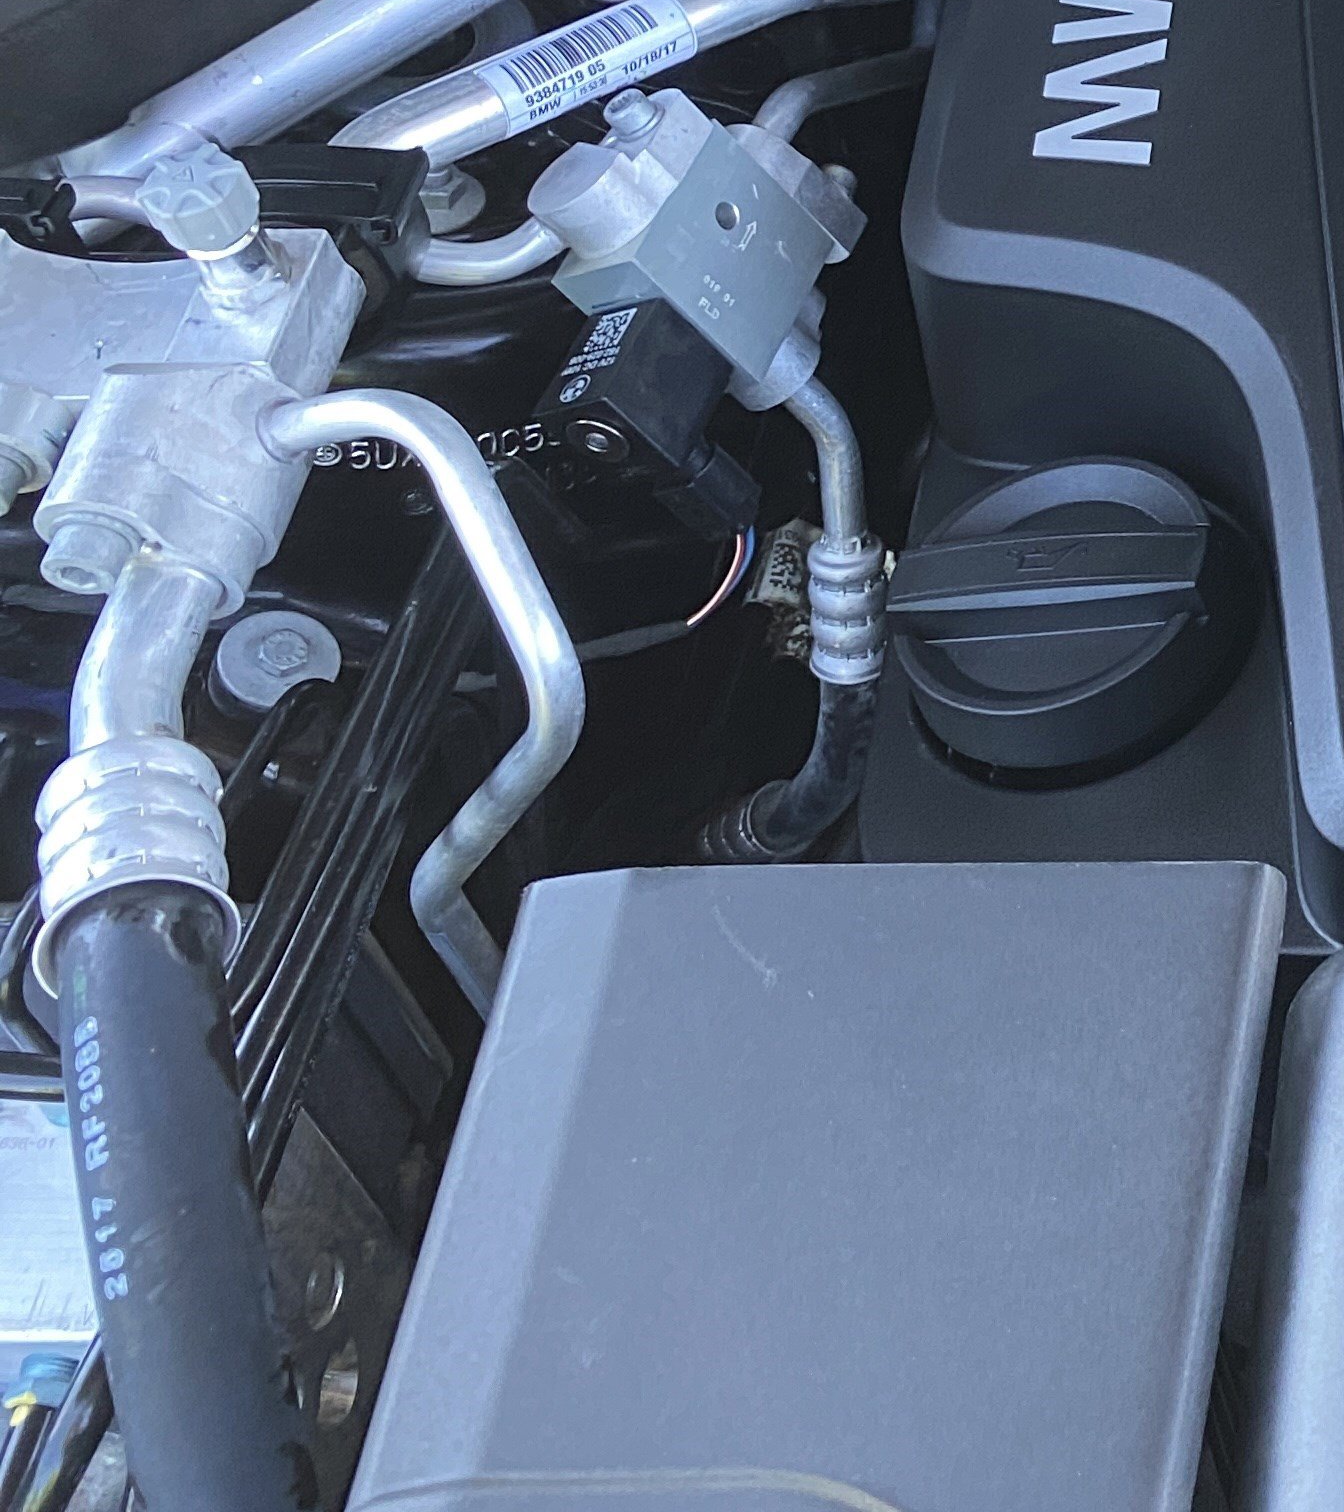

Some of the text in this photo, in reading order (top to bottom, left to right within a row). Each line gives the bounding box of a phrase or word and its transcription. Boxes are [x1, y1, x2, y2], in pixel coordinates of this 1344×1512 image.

[525, 59, 606, 108] 9384719 05
[529, 97, 562, 121] BMW
[621, 40, 678, 76] 10/18/17
